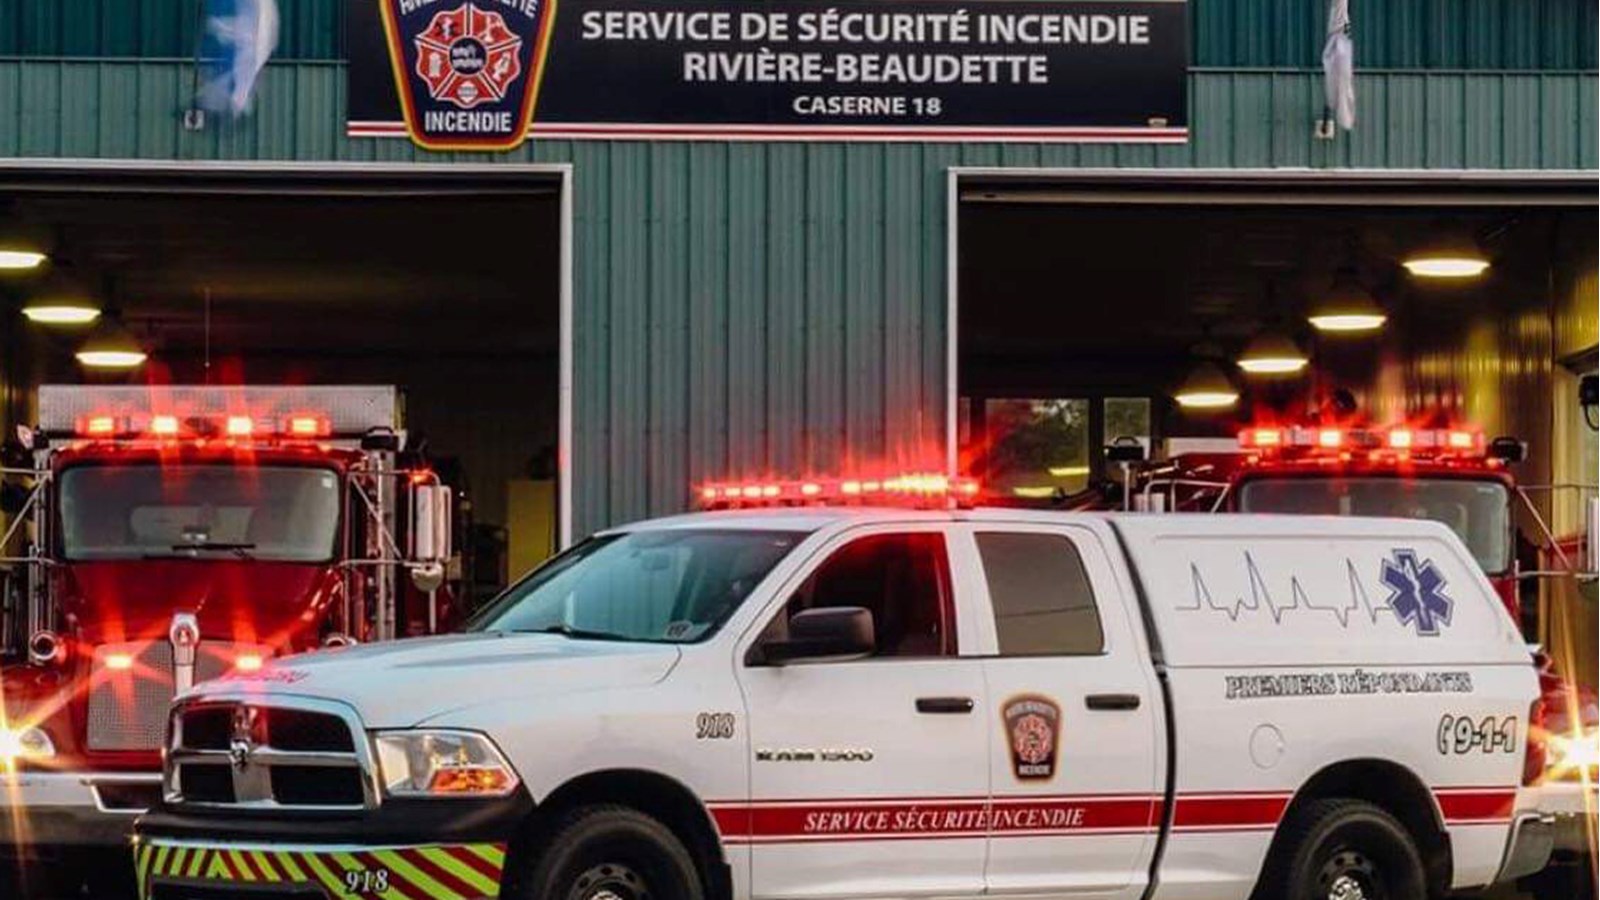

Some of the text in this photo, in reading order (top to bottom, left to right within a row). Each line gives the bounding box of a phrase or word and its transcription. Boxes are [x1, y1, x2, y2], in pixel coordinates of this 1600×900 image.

[582, 8, 1150, 44] SERVICE DE SÉCURITÉ INCENDIE
[684, 47, 1048, 84] RIVIÈRE-BEAUDETTE
[793, 96, 942, 115] CASERNE 18
[425, 110, 512, 132] INCENDIE
[1225, 673, 1338, 699] PREMIERS
[696, 712, 735, 739] 918
[1454, 716, 1517, 754] 9-1-1
[804, 806, 1086, 832] SERVICE SÉCURITÉ INCENDIE
[345, 867, 389, 893] 918
